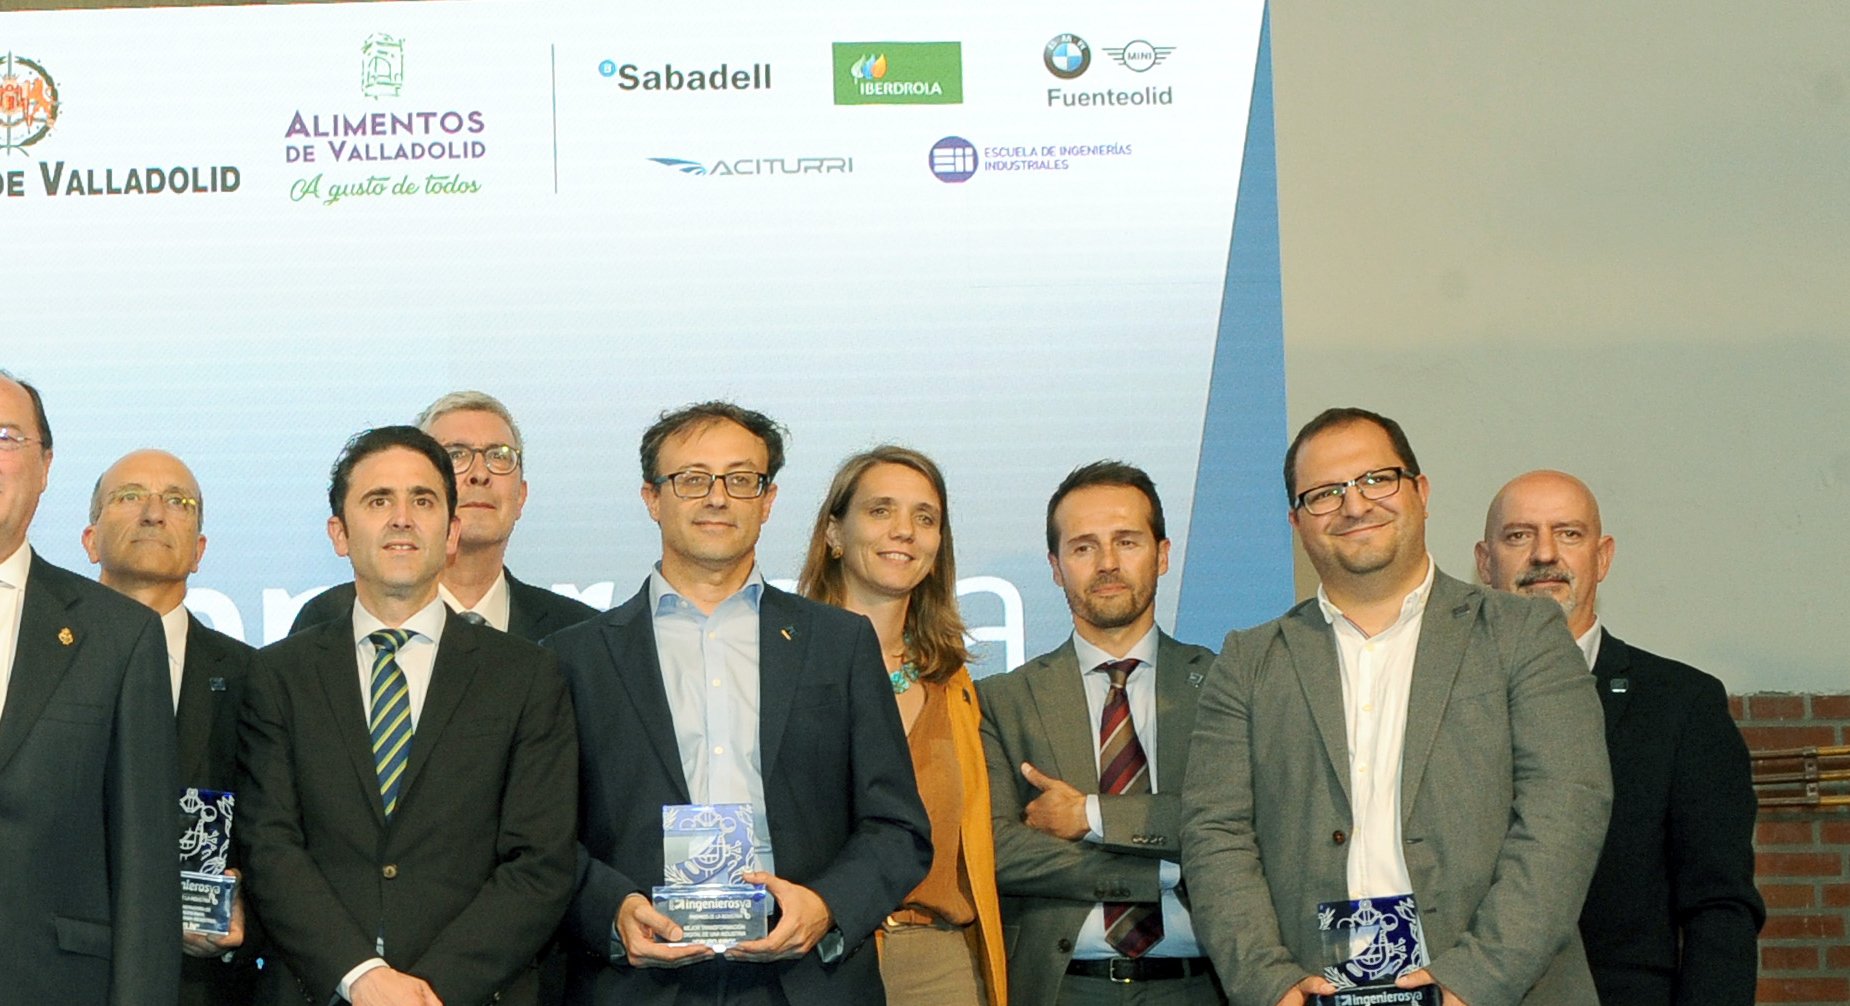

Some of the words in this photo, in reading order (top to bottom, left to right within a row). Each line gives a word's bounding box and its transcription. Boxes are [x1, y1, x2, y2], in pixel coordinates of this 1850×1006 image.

[1128, 52, 1151, 60] MINI
[618, 64, 771, 90] Sabadell
[860, 82, 943, 95] IBERDROLA
[1047, 86, 1173, 107] Fuenteolid
[284, 109, 485, 138] ALIMENTOS
[286, 145, 315, 163] DE
[328, 140, 486, 162] VALLADOLID
[984, 146, 1038, 158] ESCUELA
[1041, 146, 1056, 157] DE
[1059, 142, 1133, 156] INGENIERÍAS
[709, 157, 853, 175] ACITURRI
[984, 160, 1069, 171] INDUSTRIALES
[39, 161, 241, 196] VALLADOLID
[289, 173, 323, 201] A
[323, 175, 391, 206] gusto
[392, 175, 420, 194] de
[425, 173, 482, 194] todos
